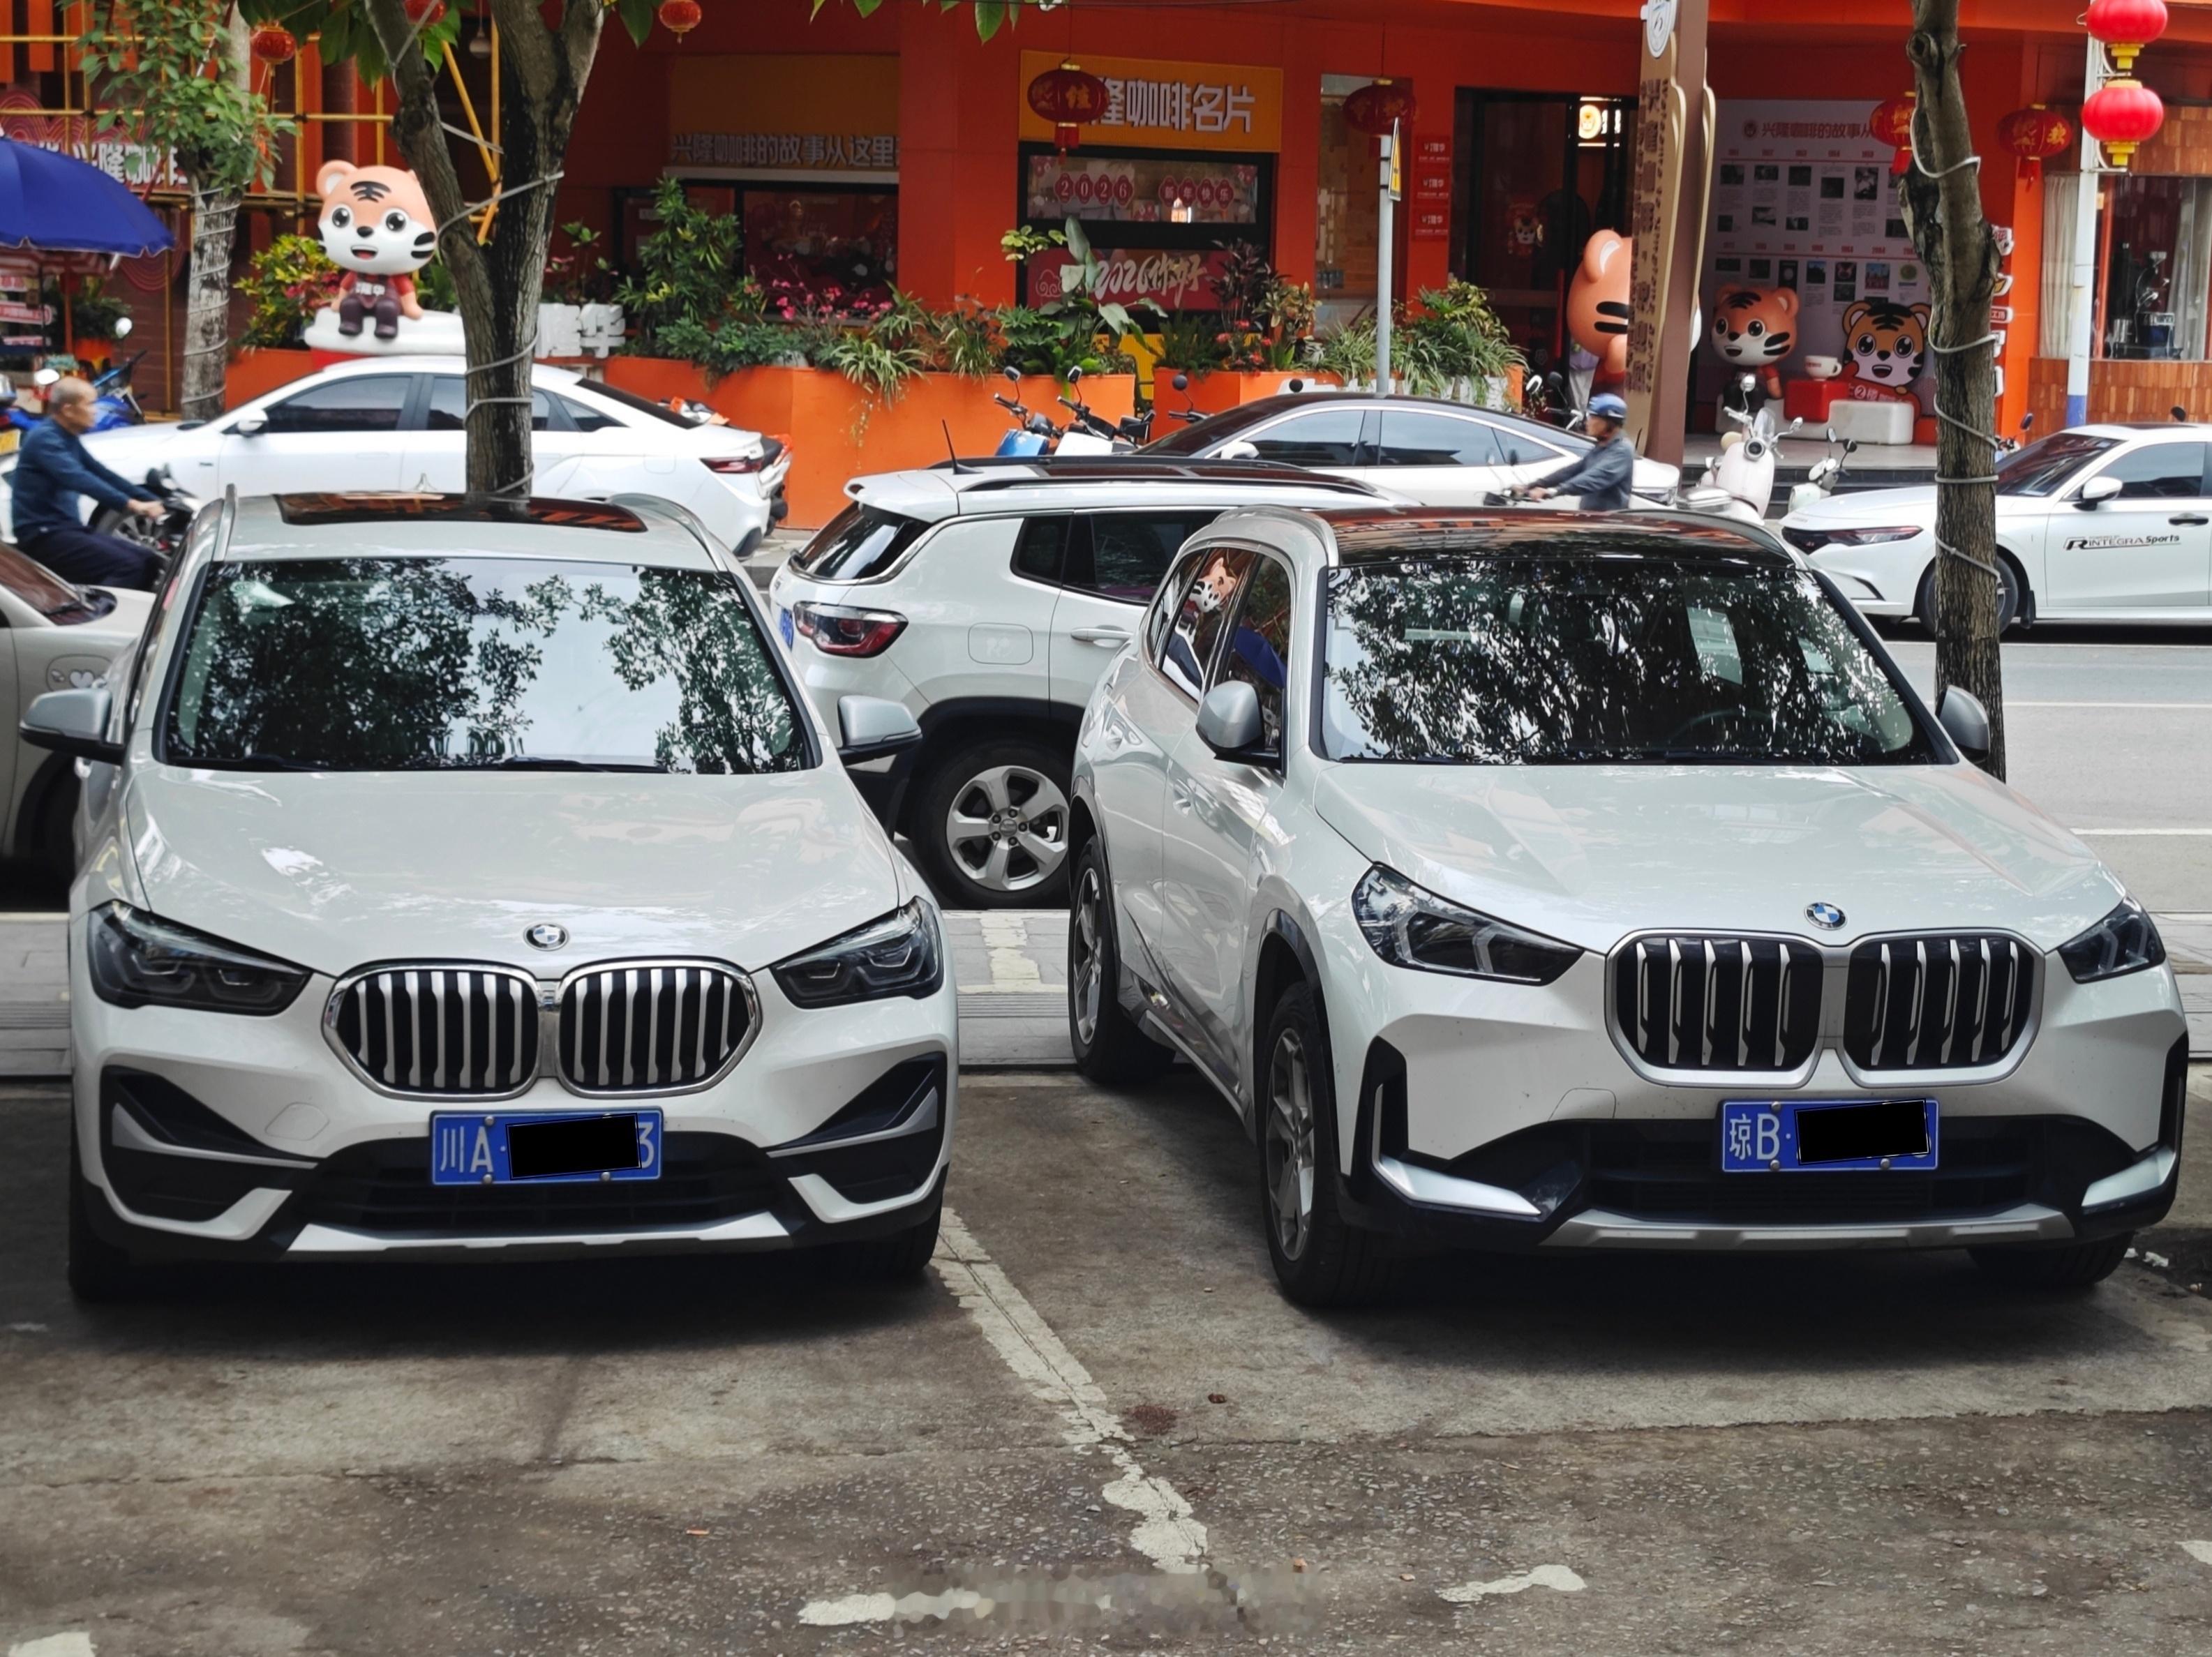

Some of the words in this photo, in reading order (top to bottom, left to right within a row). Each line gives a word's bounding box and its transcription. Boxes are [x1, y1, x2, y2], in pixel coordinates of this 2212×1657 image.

[673, 134, 899, 167] 兴隆咖啡的故事从这里
[1061, 179, 1128, 198] 2026
[1164, 185, 1230, 203] 新年快乐
[2088, 537, 2144, 547] INTEGRA
[2146, 534, 2180, 545] Sports
